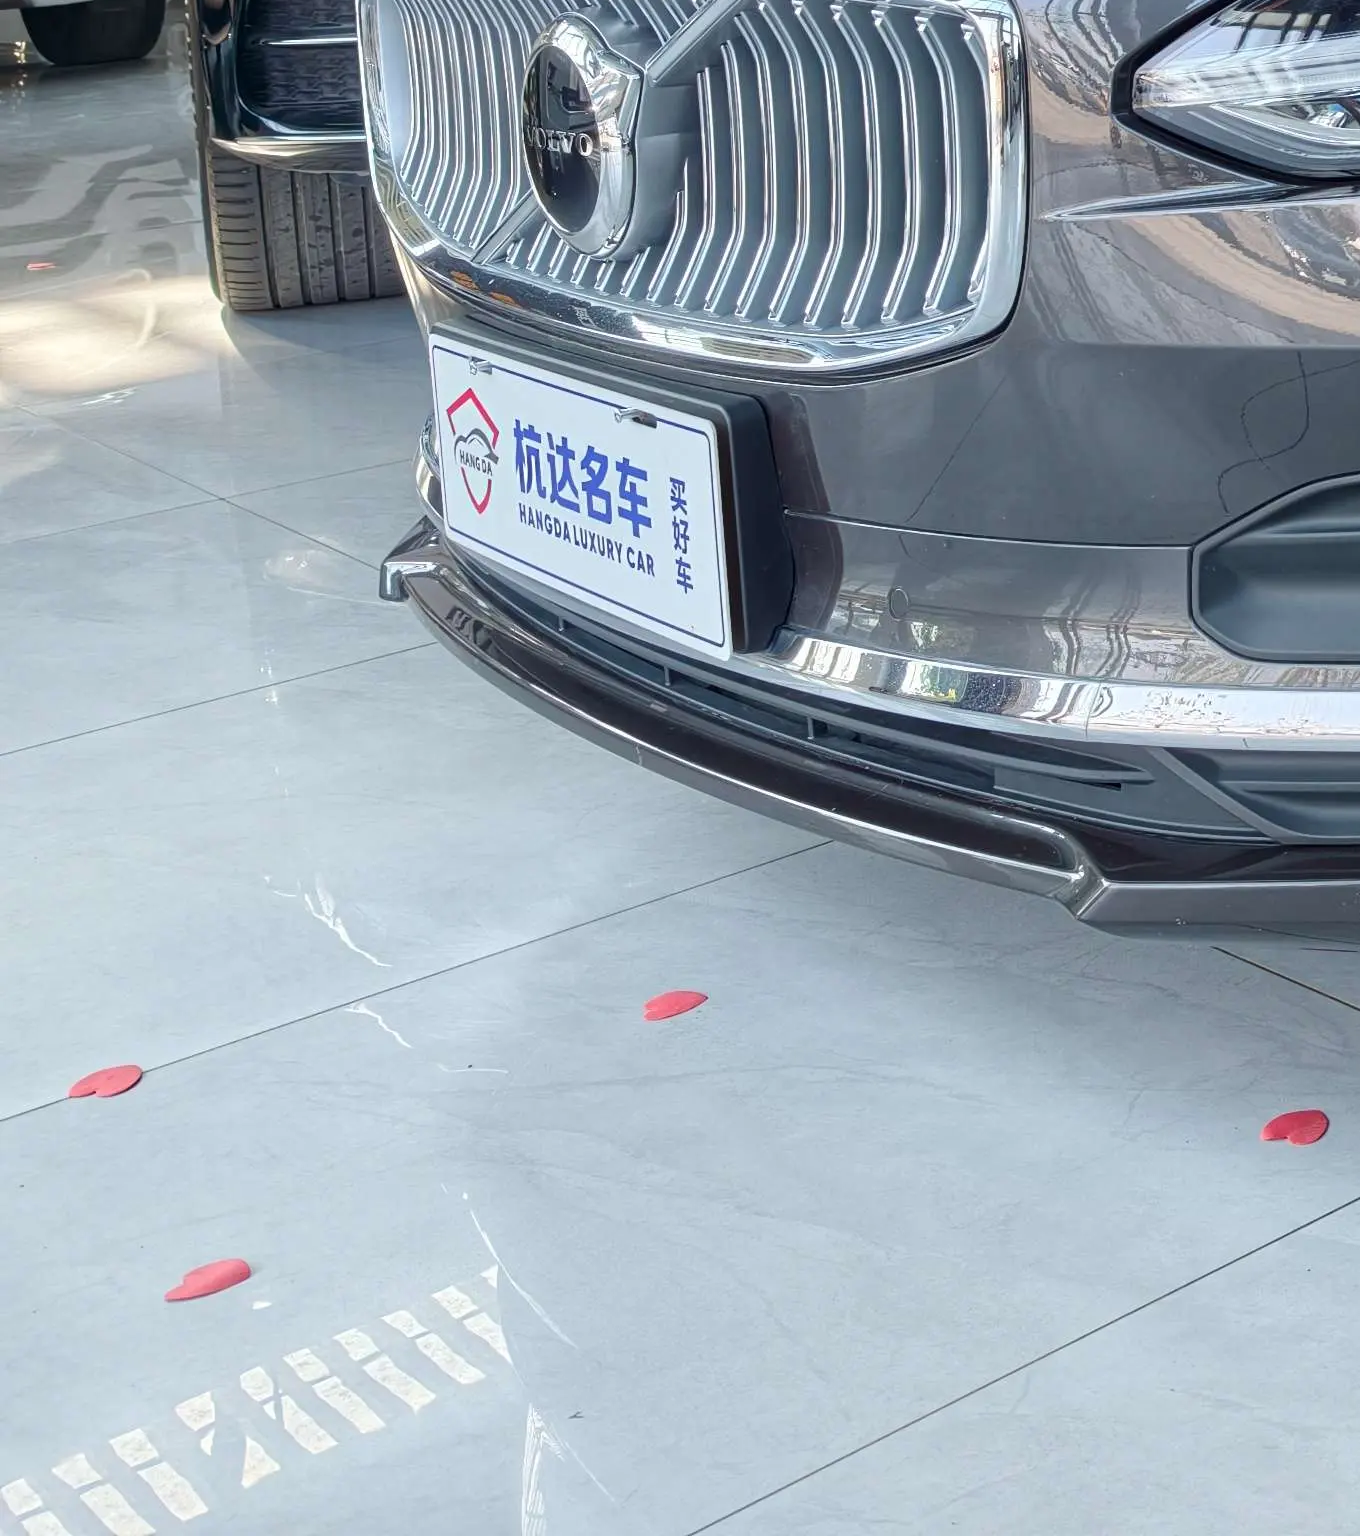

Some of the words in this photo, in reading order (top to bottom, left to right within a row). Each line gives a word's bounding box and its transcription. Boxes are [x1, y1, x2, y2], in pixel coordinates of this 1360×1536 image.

[526, 128, 594, 158] VOLVO
[513, 418, 653, 539] 杭达名车
[518, 503, 571, 542] HANGDA
[572, 530, 623, 565] LUXURY
[626, 546, 655, 578] CAR
[669, 476, 694, 595] 买好车
